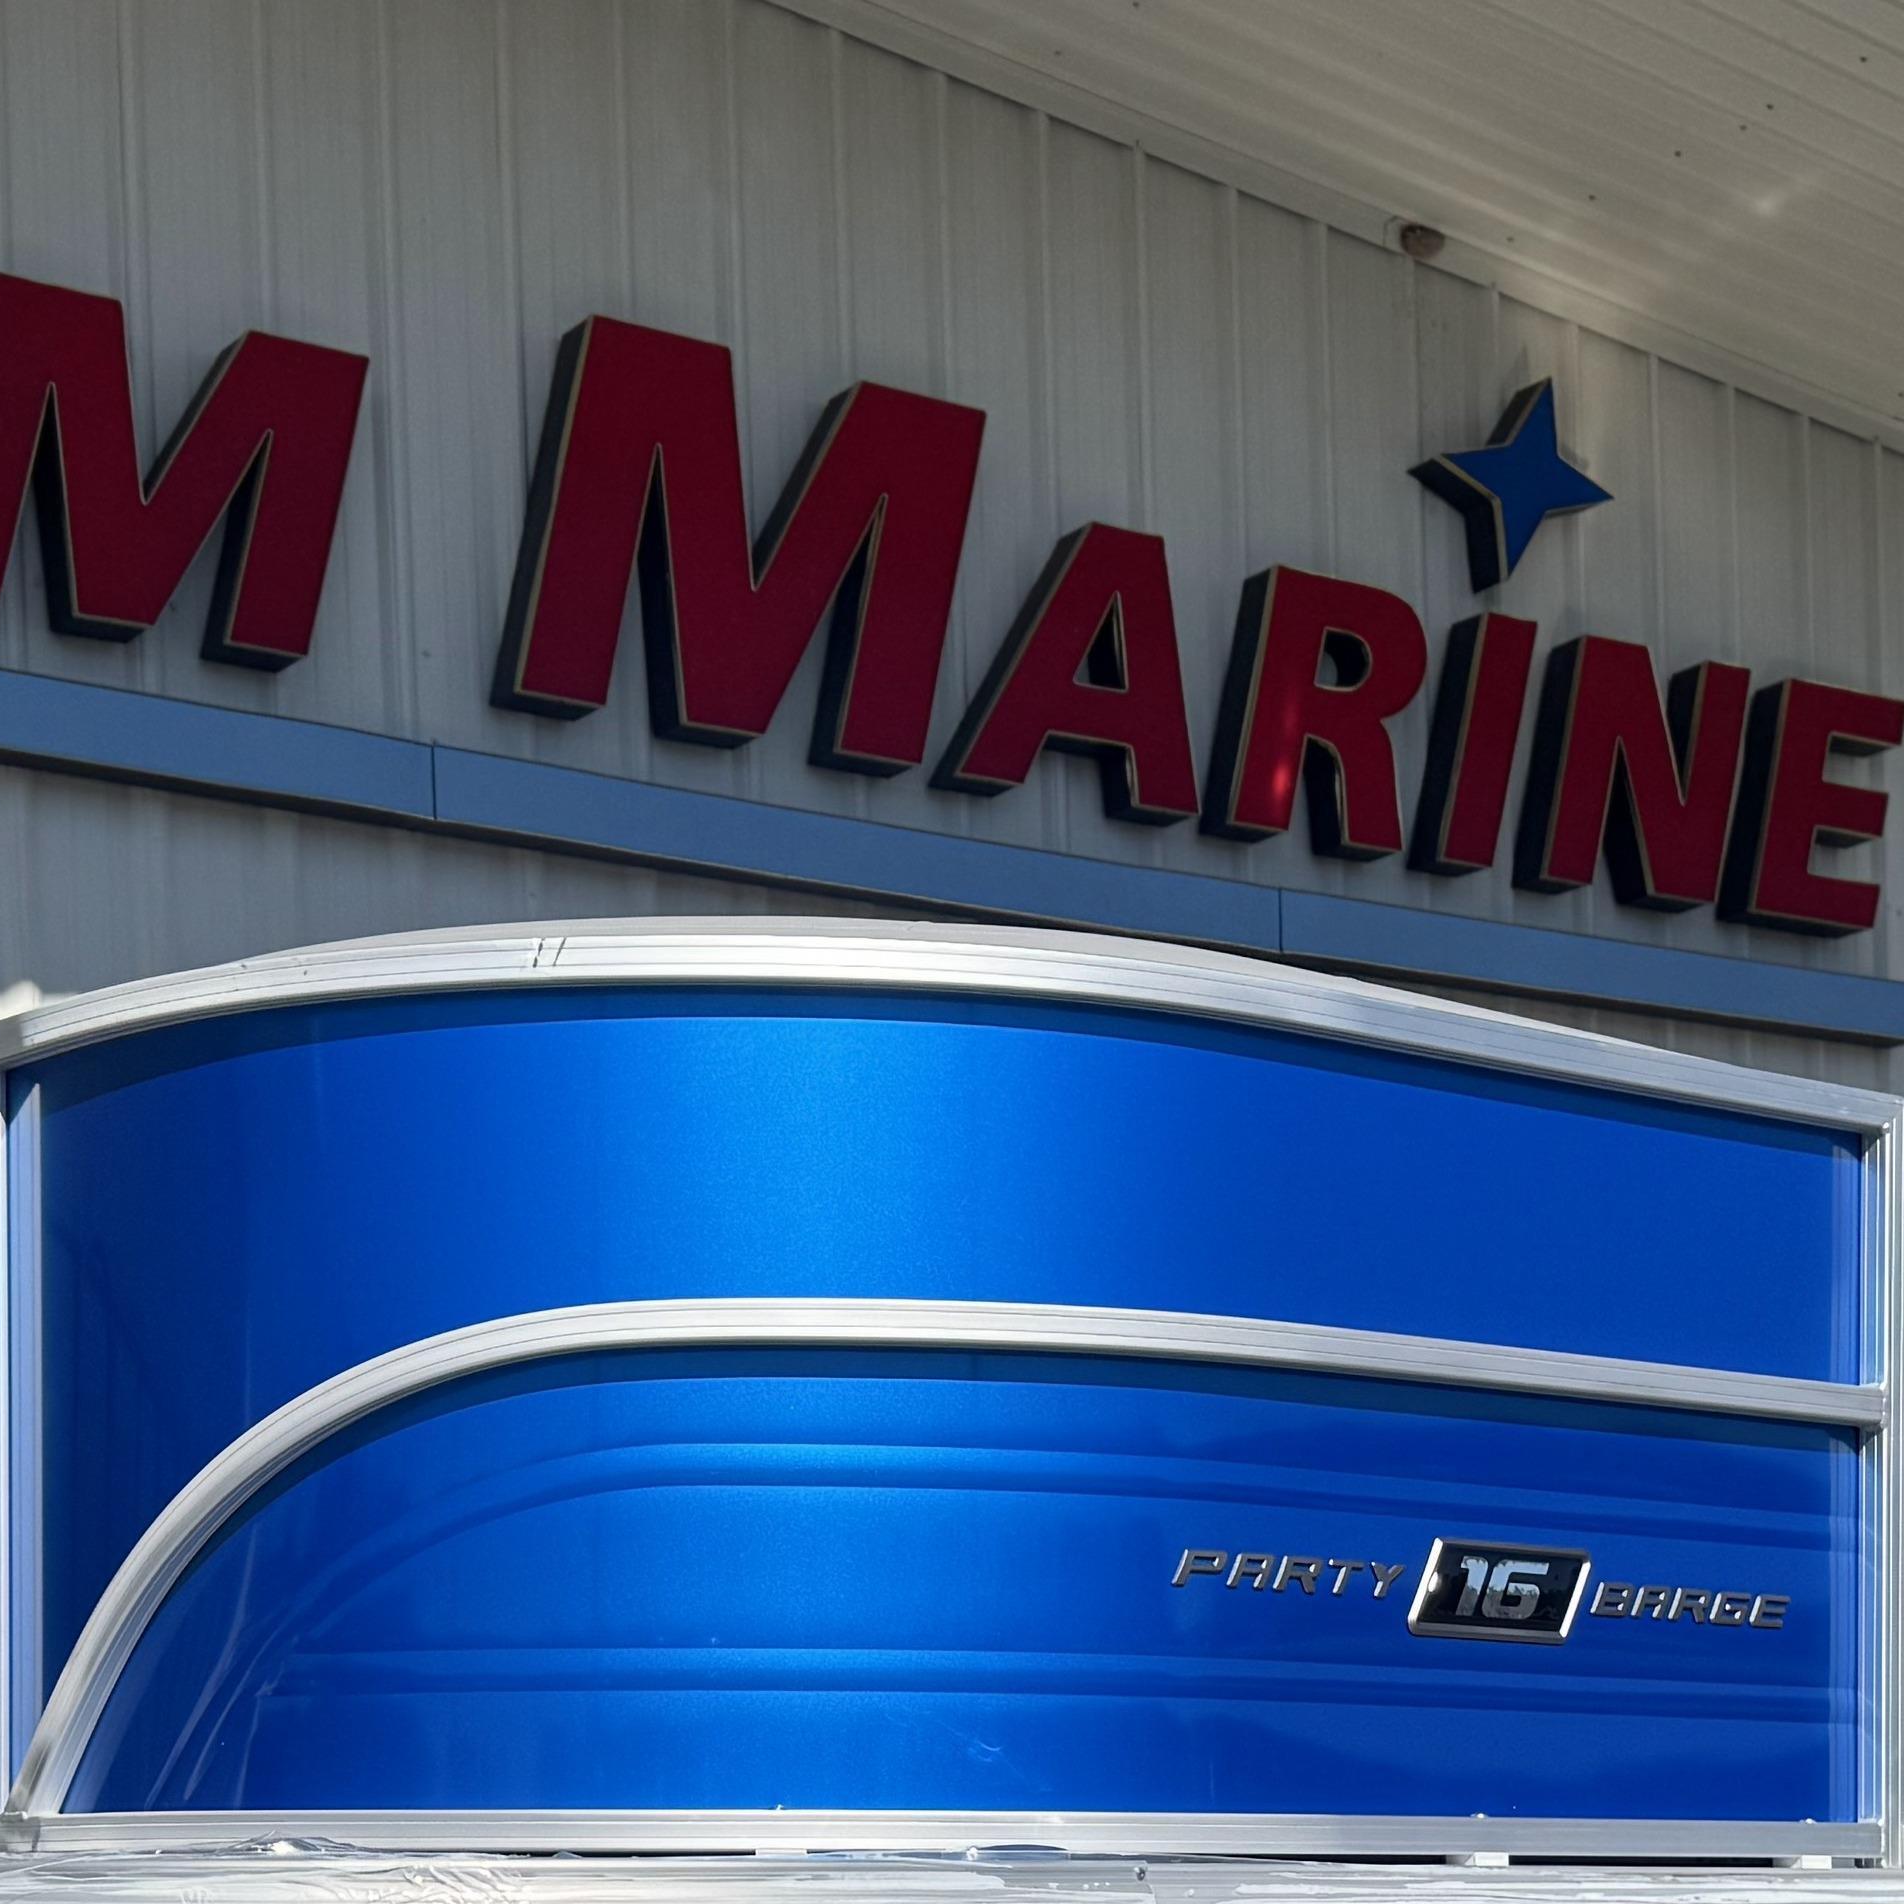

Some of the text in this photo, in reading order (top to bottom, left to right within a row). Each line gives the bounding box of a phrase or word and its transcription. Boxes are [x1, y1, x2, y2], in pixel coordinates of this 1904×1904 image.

[1171, 1548, 1791, 1629] PARTY 16 BARGE
